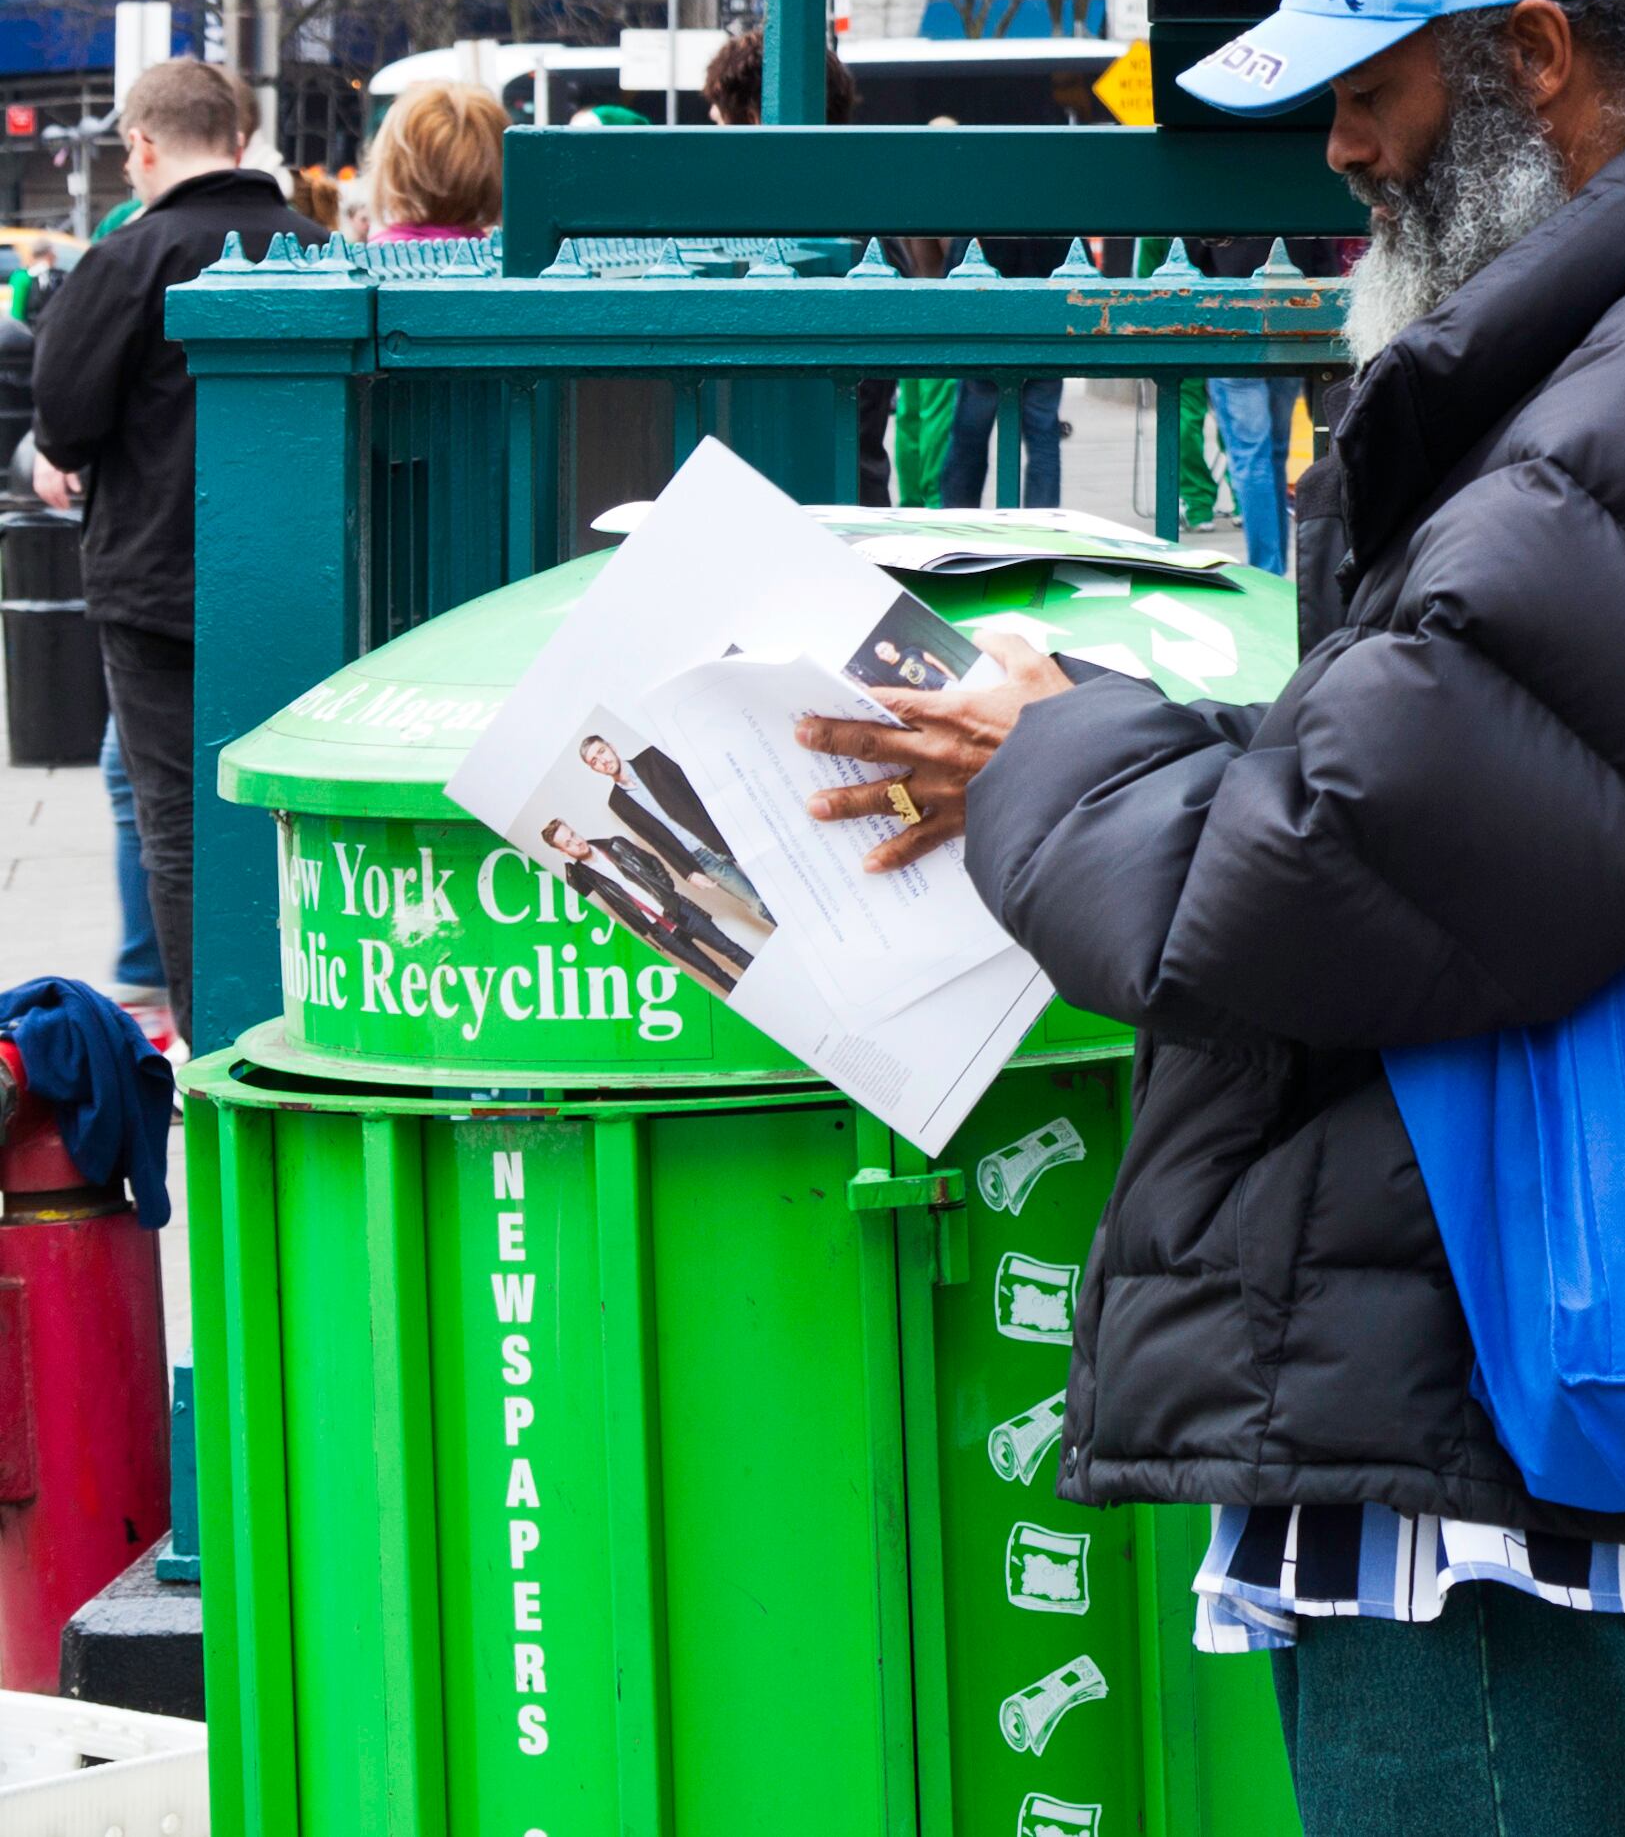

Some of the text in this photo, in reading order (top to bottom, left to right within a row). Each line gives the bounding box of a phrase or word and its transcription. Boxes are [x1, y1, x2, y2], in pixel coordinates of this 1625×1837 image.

[332, 841, 460, 923] York
[283, 928, 684, 1043] ublic Recycling
[490, 1150, 550, 1756] NEWSPAPERS
